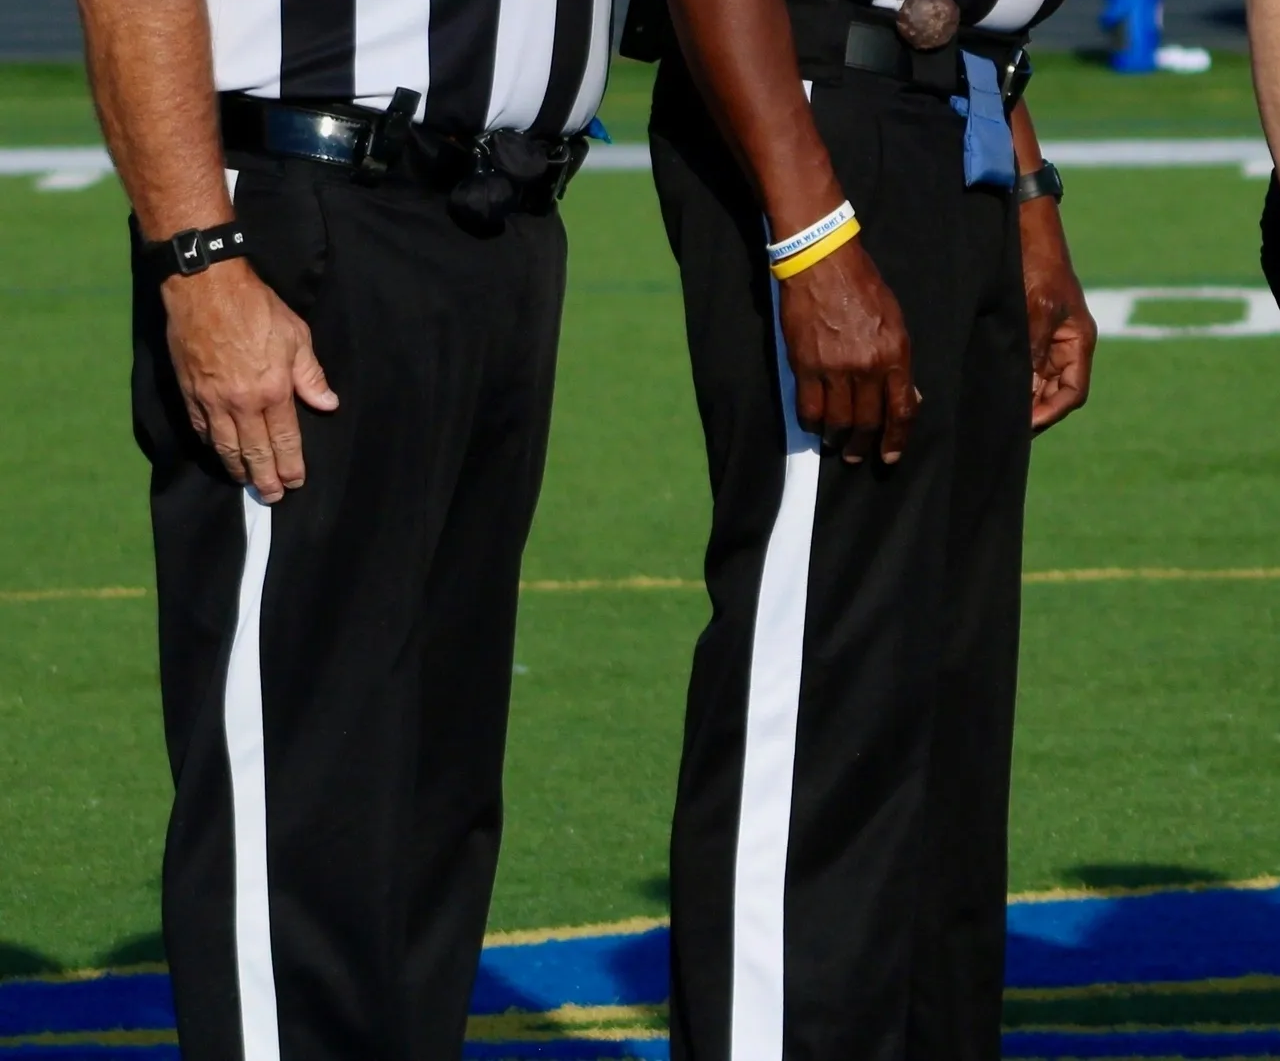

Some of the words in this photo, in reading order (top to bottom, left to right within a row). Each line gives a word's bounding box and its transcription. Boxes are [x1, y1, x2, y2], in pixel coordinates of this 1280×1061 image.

[803, 231, 817, 242] WE
[818, 219, 838, 236] FIGHT
[209, 238, 224, 251] 2
